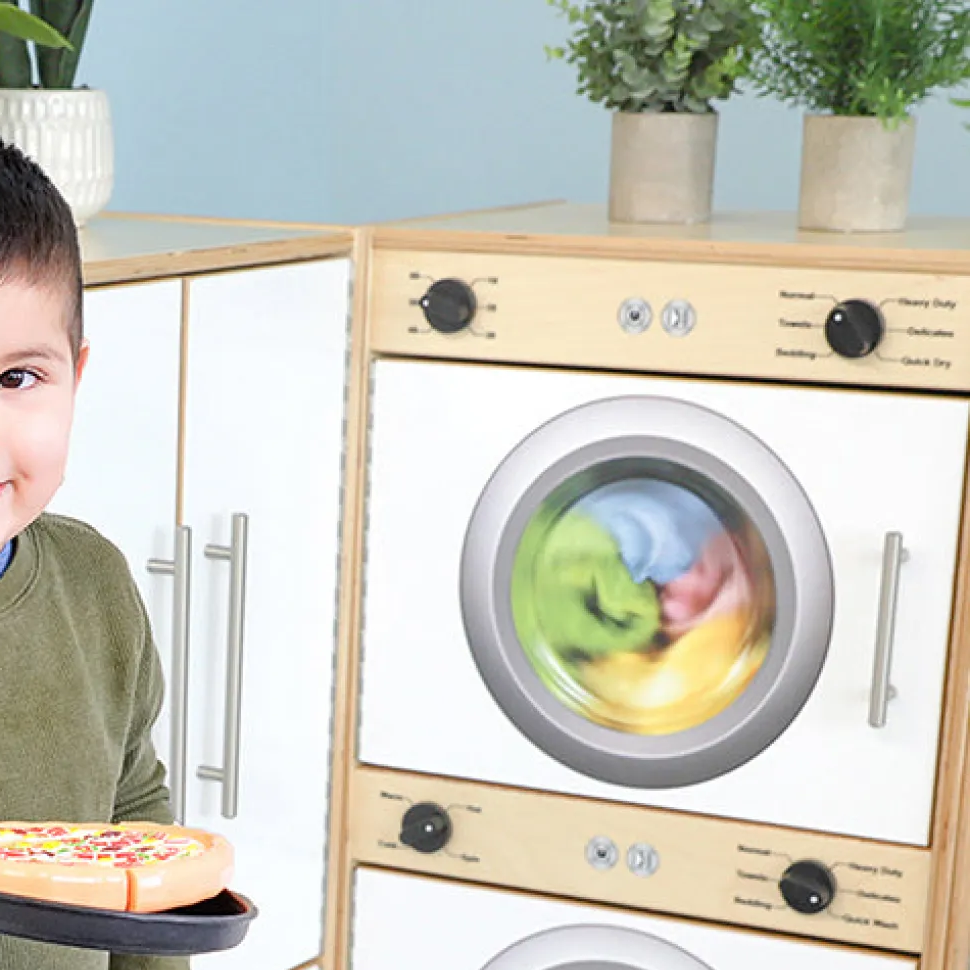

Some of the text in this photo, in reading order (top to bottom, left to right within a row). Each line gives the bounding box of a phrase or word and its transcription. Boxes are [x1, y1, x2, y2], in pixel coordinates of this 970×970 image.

[898, 298, 957, 311] Heavy Duty
[900, 356, 952, 370] Quick Dry
